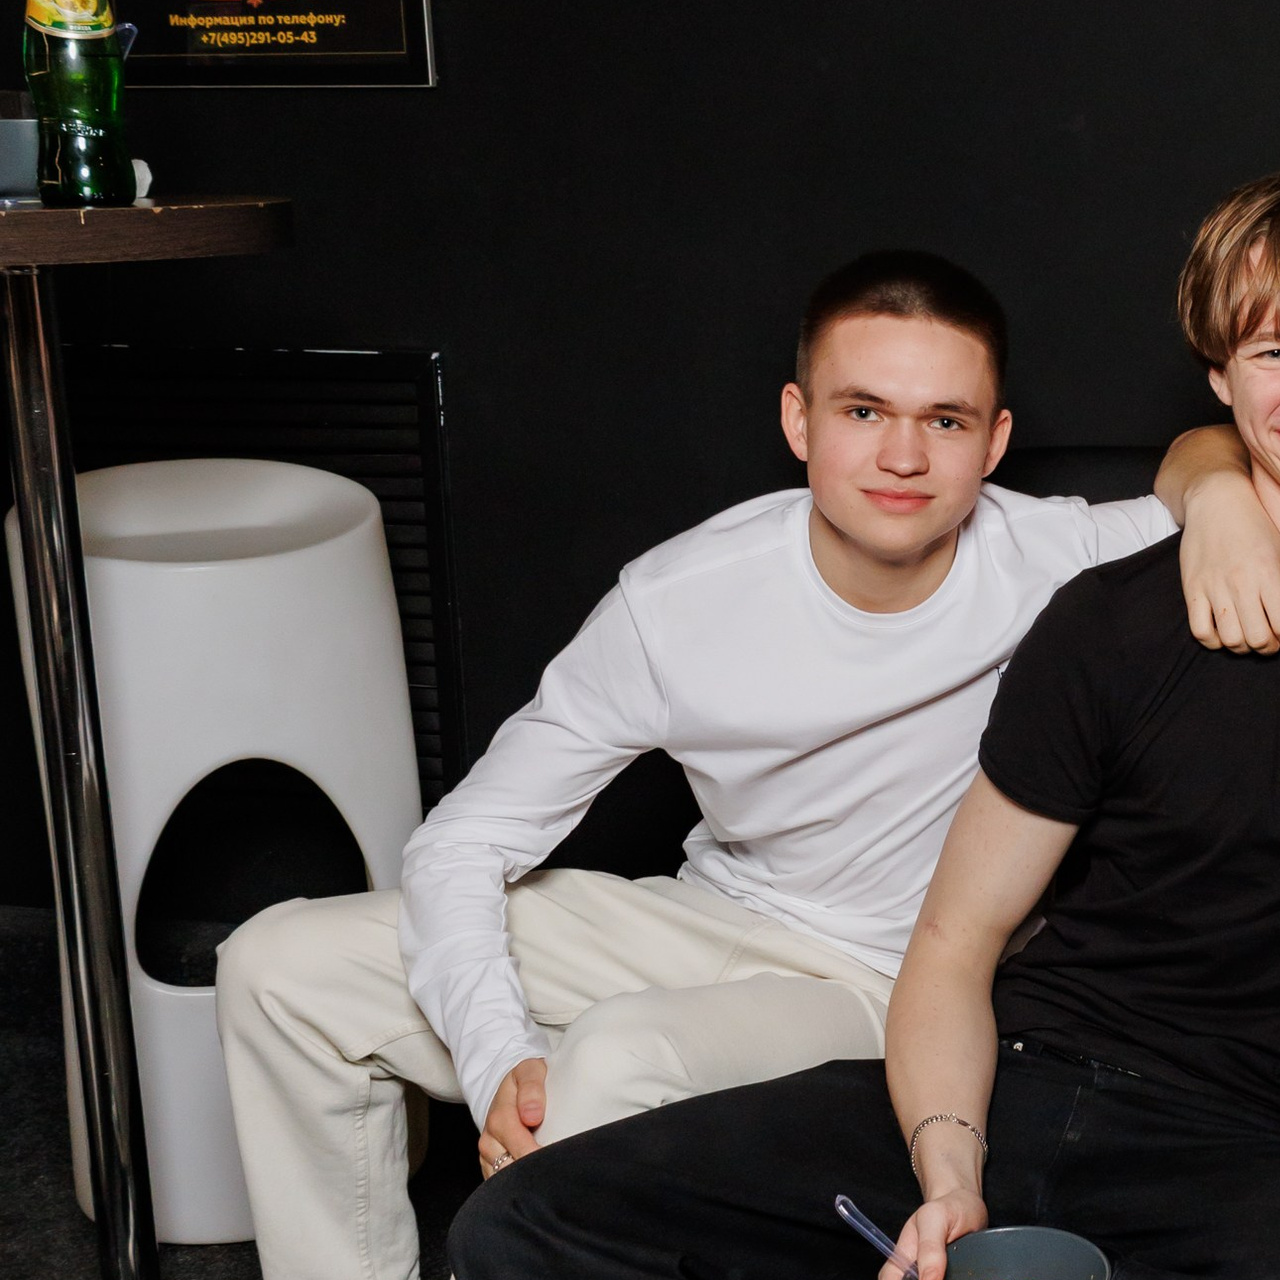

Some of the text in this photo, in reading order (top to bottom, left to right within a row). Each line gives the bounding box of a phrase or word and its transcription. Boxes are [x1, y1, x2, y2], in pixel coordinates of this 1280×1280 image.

[169, 13, 347, 28] Информация по телефону:
[201, 30, 318, 48] +7(495)291-05-43
